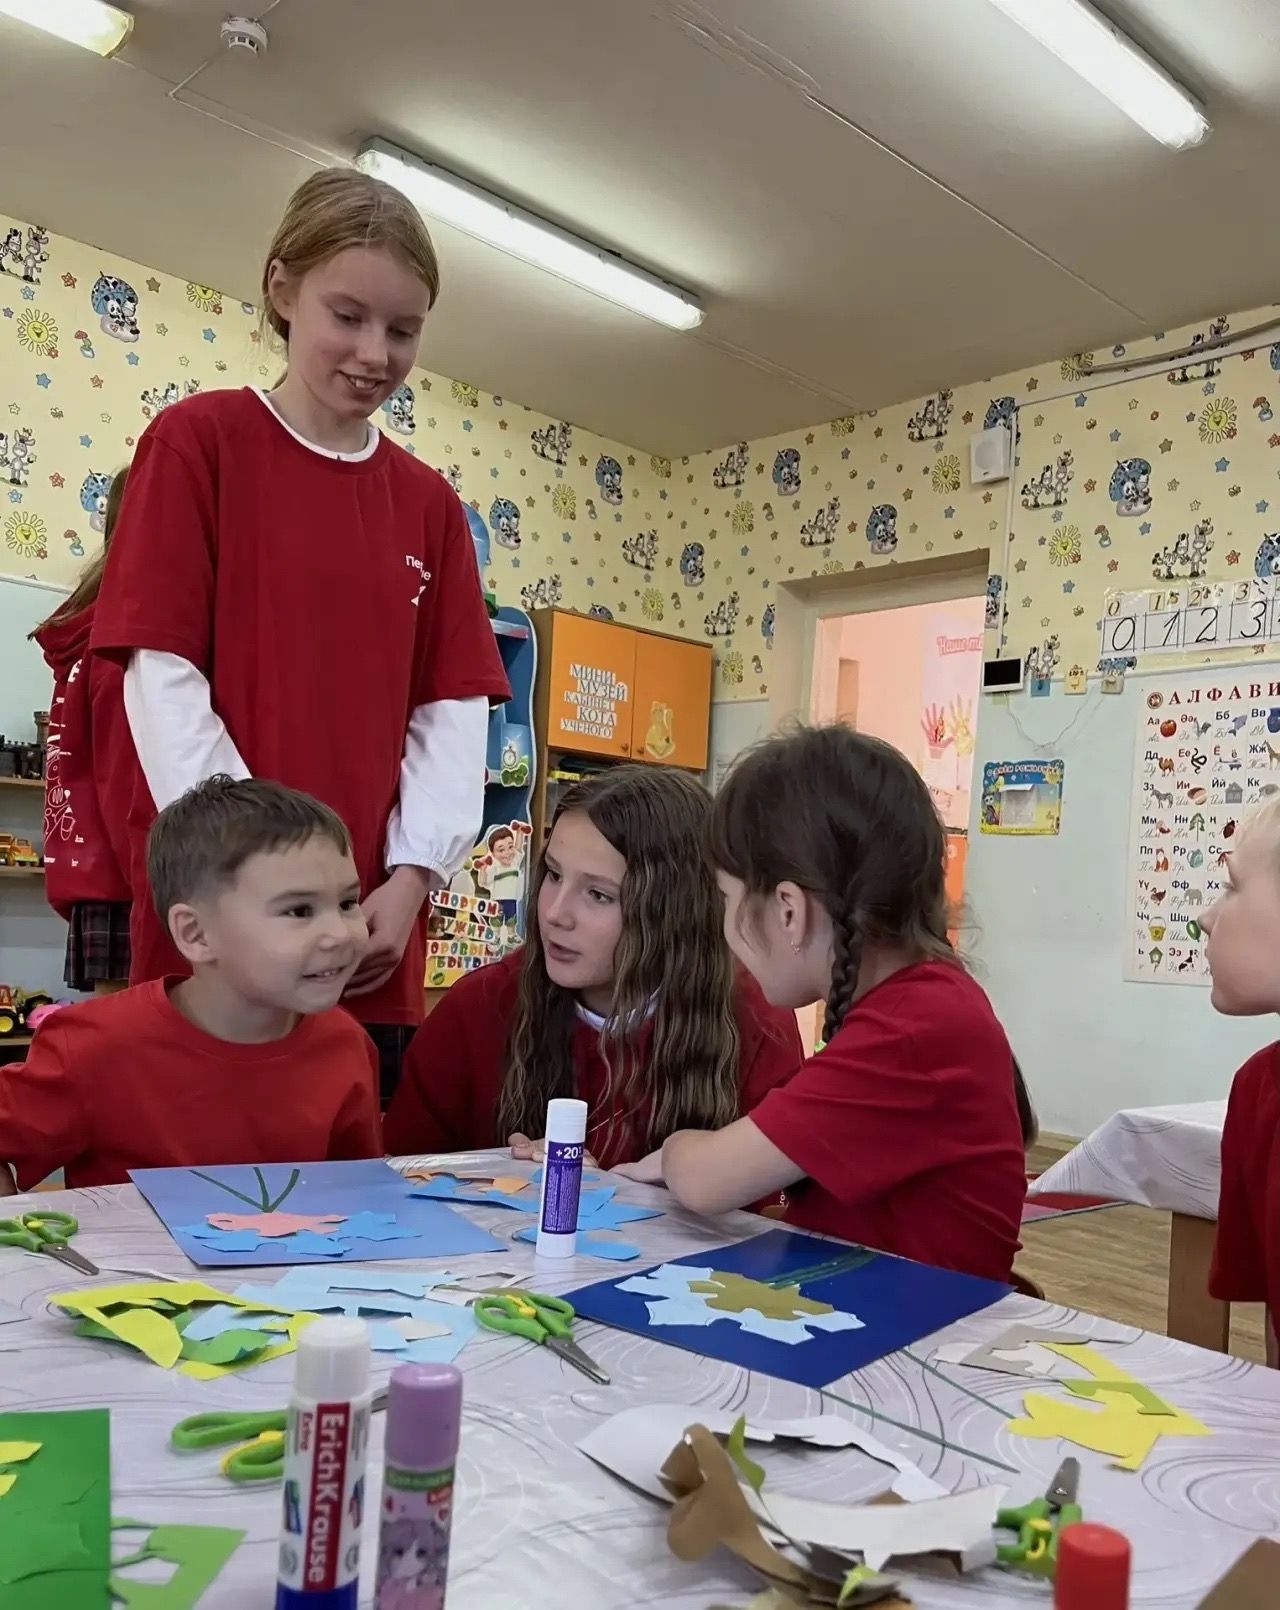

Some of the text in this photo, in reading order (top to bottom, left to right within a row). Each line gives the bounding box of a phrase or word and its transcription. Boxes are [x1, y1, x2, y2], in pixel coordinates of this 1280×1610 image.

[1108, 583, 1249, 616] 0 1 2 3
[1112, 600, 1267, 651] 0 1 2 3
[572, 664, 613, 685] МИНИ
[580, 680, 625, 700] МУЗЕЙ
[579, 707, 615, 727] КОТА
[1147, 717, 1160, 725] Аа
[1216, 710, 1230, 720] Бб
[1251, 708, 1266, 718] Вв
[563, 720, 612, 737] УЧЕНОГО
[1144, 750, 1158, 760] Дд
[1179, 748, 1191, 757] Ее
[1249, 744, 1266, 753] Жж
[1143, 778, 1260, 791] Зз Ии Йй Кк
[1141, 816, 1157, 824] Мм
[1175, 815, 1188, 824] Нн
[1140, 846, 1222, 856] Пп Рр Сс
[1172, 880, 1189, 891] Фф
[1207, 880, 1220, 890] Хх
[431, 891, 497, 915] СПОРТОМ
[1137, 912, 1189, 922] Чч Шш
[1169, 947, 1182, 957] Ээ
[308, 1413, 345, 1583] ErichKrause
